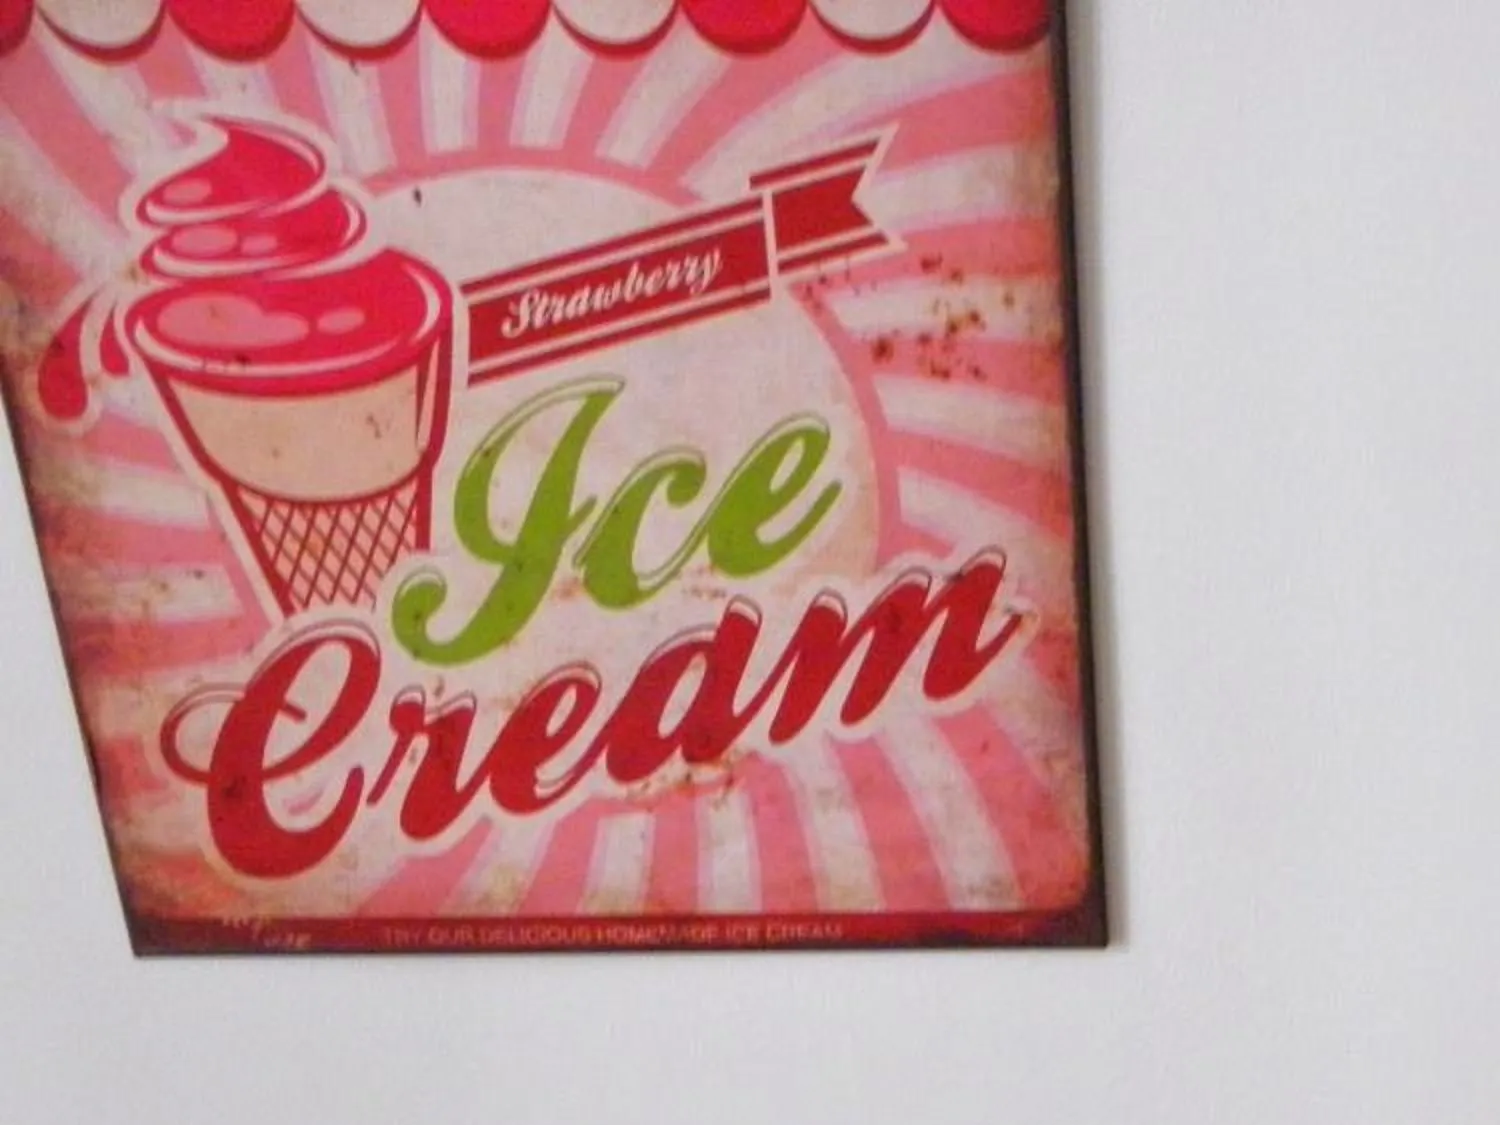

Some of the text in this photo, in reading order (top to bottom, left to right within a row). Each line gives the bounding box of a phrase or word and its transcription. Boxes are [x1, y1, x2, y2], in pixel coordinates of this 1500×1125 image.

[500, 246, 725, 340] Strawberry
[391, 376, 843, 667] Ice
[161, 545, 1022, 880] Cream
[428, 925, 474, 945] OUR
[479, 924, 590, 945] DELICIOUS
[724, 922, 759, 942] ICE
[765, 921, 843, 941] CREAM
